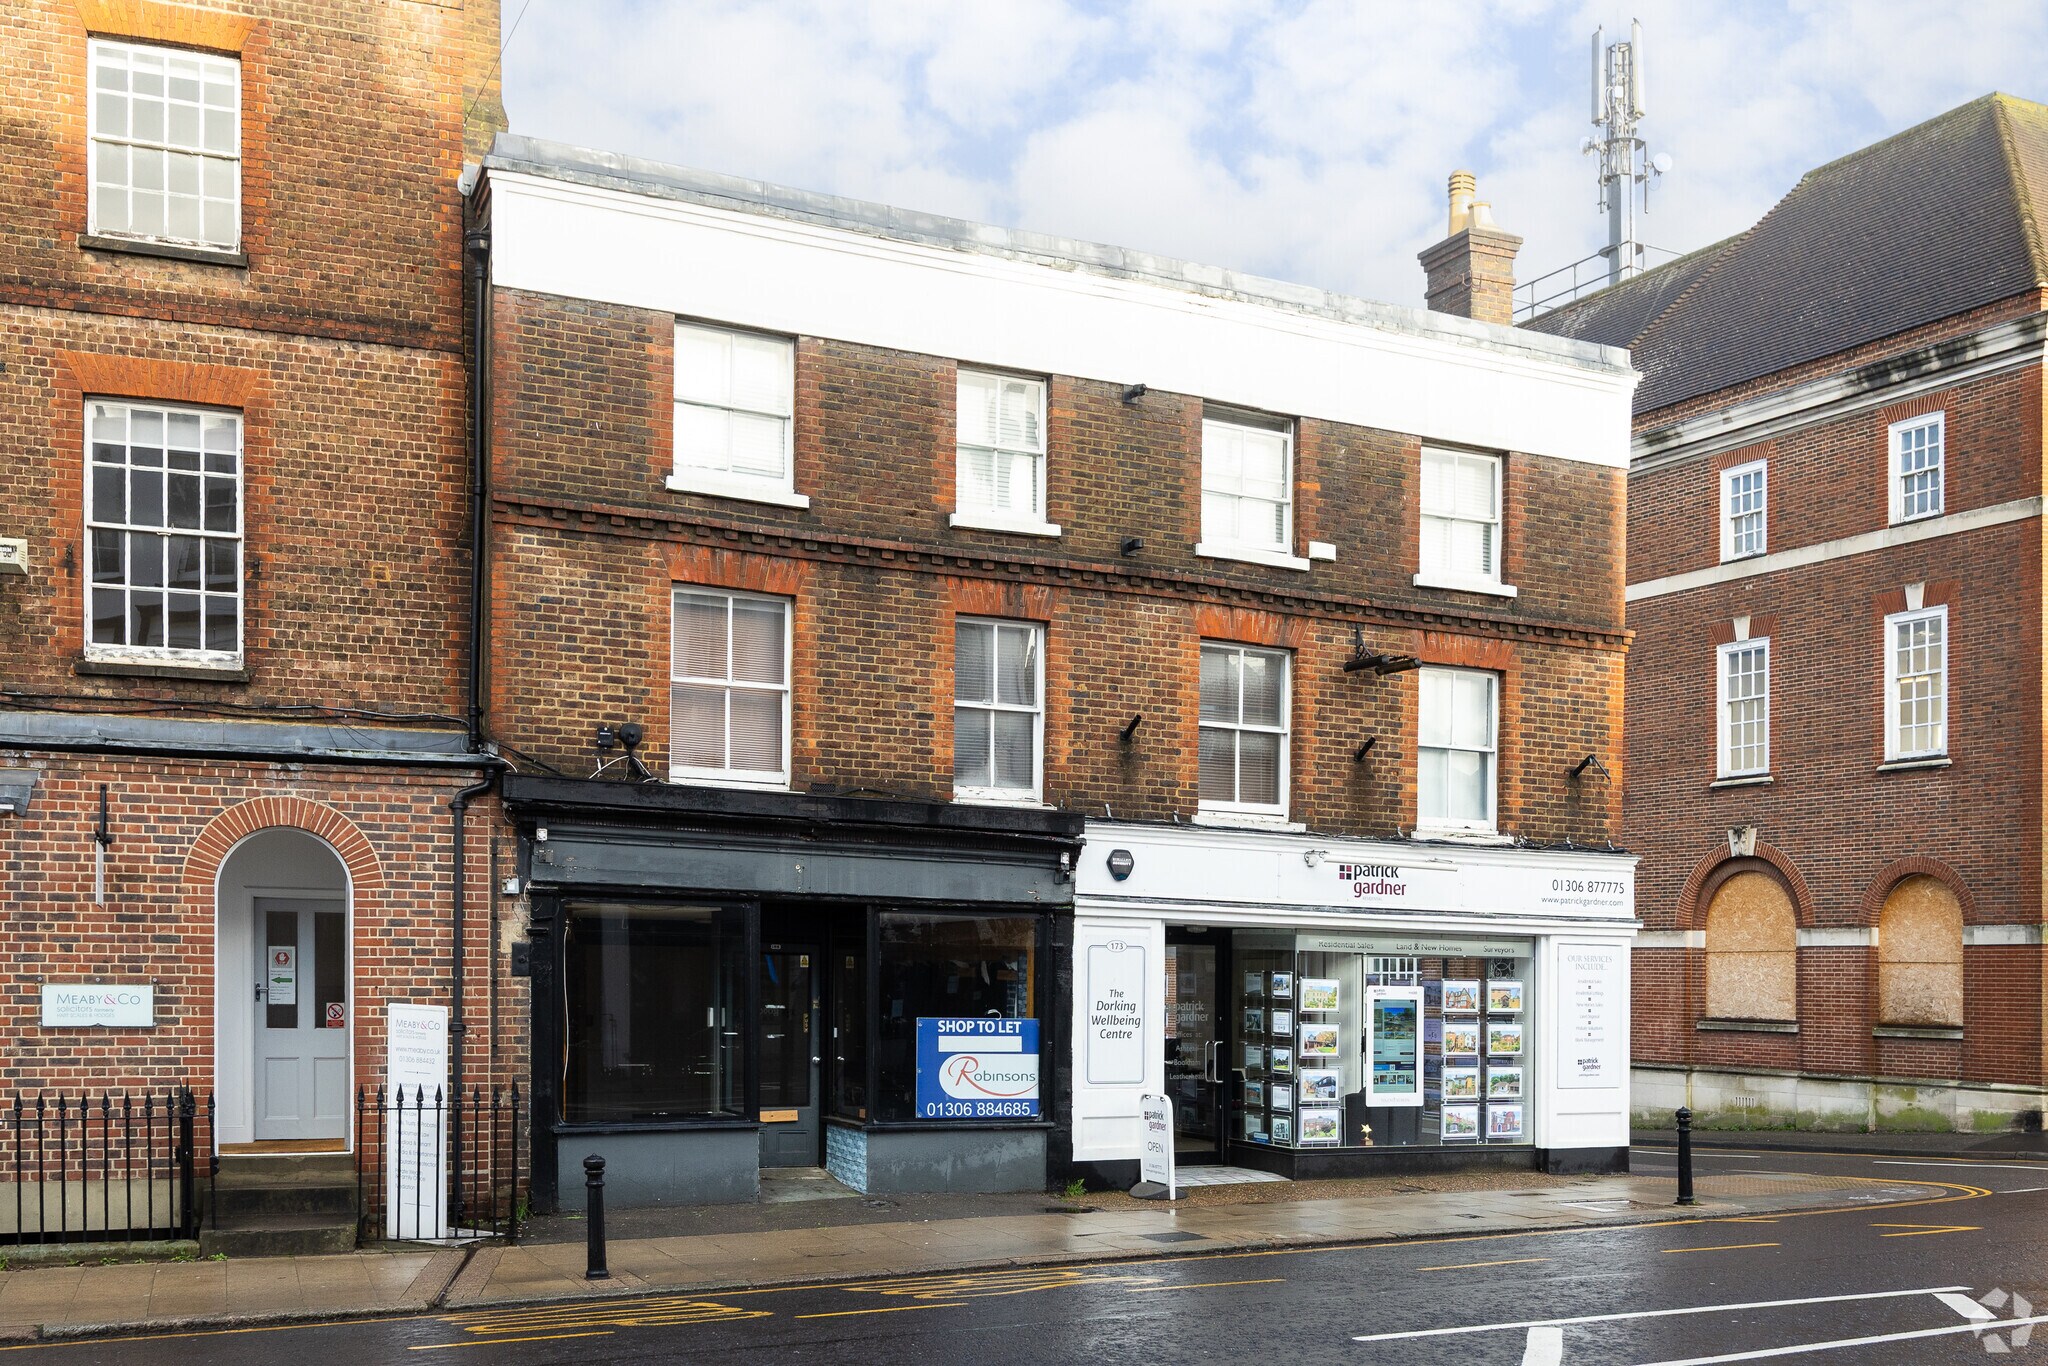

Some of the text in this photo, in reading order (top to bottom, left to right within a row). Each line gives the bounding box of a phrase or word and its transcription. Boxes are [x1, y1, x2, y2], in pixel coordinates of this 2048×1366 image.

[1354, 865, 1399, 880] patrick
[1354, 879, 1407, 898] gardner
[1552, 879, 1625, 894] 01306 877775
[1541, 896, 1624, 907] www.patrickgardner.com
[1318, 941, 1374, 950] Residential Sales
[1438, 944, 1463, 952] Homes
[1483, 945, 1515, 954] Surveyors
[1567, 954, 1612, 963] OUR SERVICES
[1109, 989, 1125, 998] The
[56, 1005, 93, 1013] solicitors
[1096, 1000, 1137, 1014] Dorking
[1175, 1001, 1206, 1014] patrick
[1091, 1015, 1141, 1029] Wellbeing
[1175, 1012, 1209, 1023] gardner
[937, 1020, 1022, 1033] SHOP TO LET
[1100, 1028, 1133, 1039] Centre
[948, 1056, 1037, 1091] Robinsons
[926, 1102, 1031, 1116] 01306 884685
[1149, 1110, 1165, 1121] patrick
[1148, 1120, 1167, 1132] gardner
[1147, 1141, 1164, 1154] OPEN
